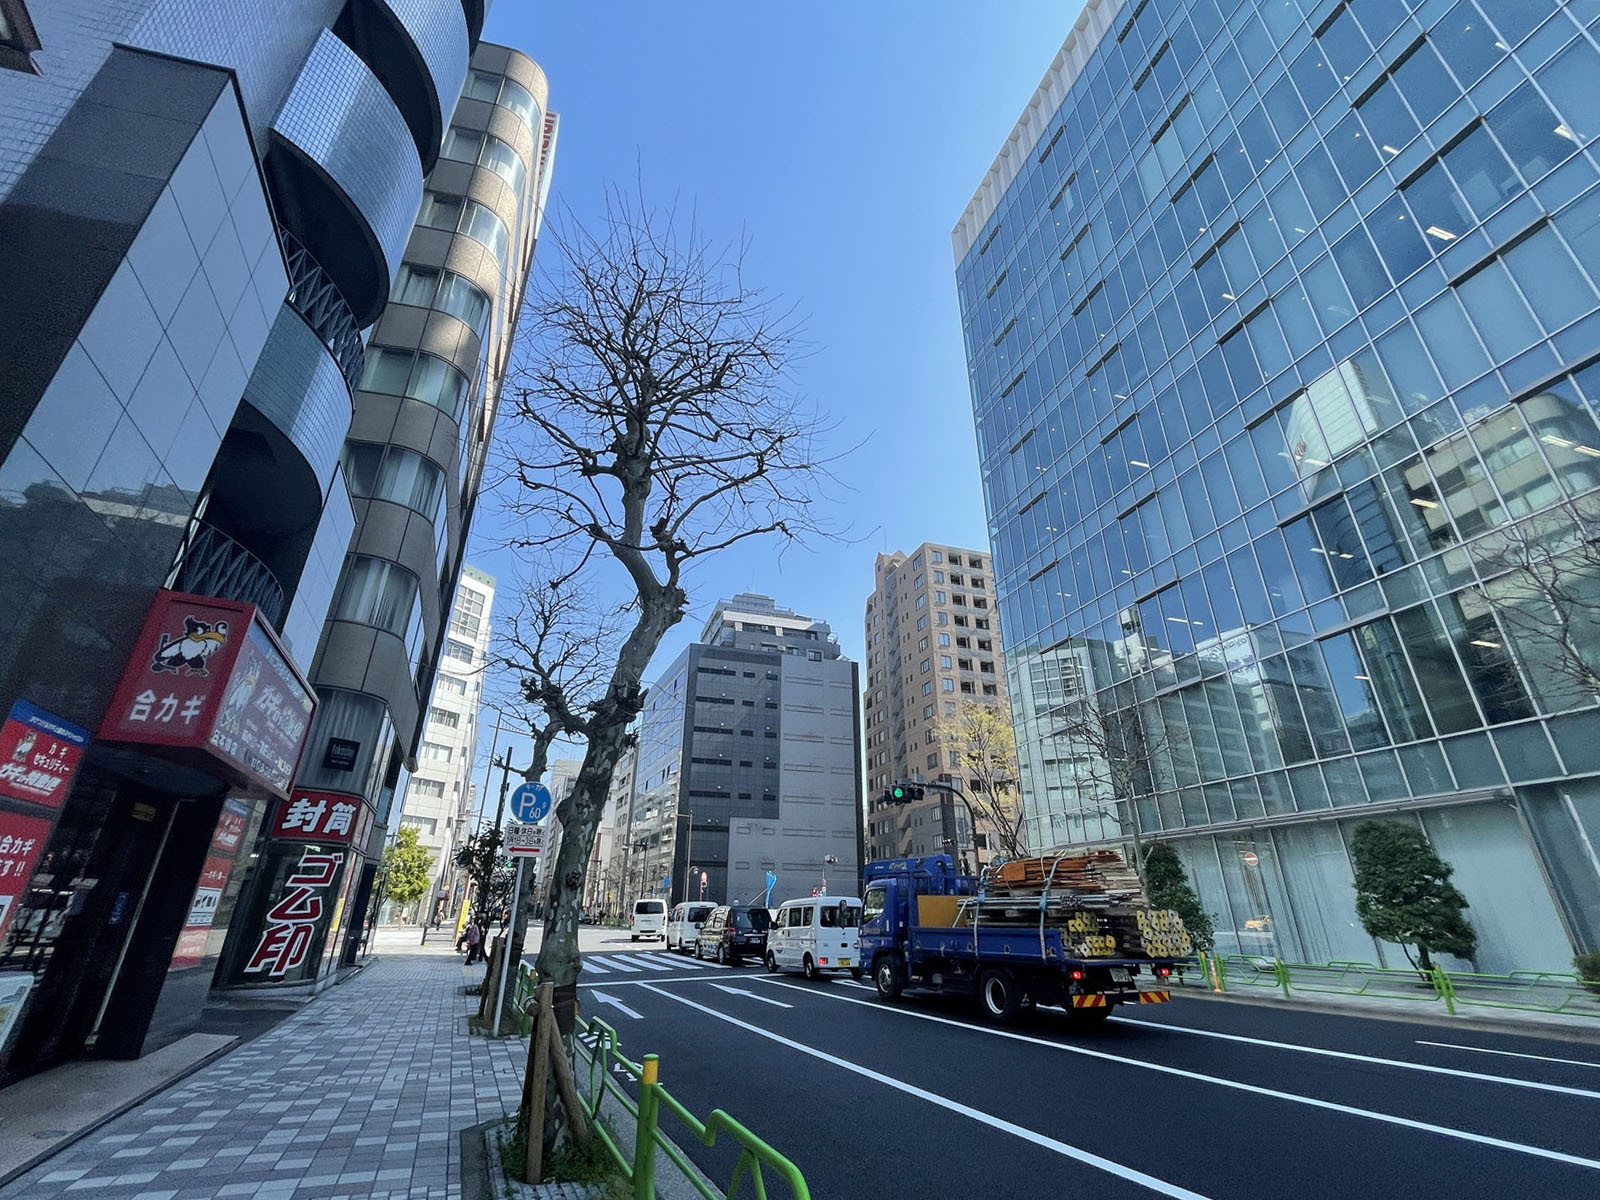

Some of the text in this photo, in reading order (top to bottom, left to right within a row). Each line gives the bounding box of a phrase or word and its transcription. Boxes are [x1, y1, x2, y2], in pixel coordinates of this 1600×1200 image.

[129, 689, 206, 724] 合カギ
[33, 752, 70, 773] セキュリティー
[281, 798, 356, 836] 封筒
[518, 792, 536, 817] P
[529, 807, 541, 819] 60
[0, 834, 35, 856] 合カギ
[243, 852, 344, 976] ゴム印
